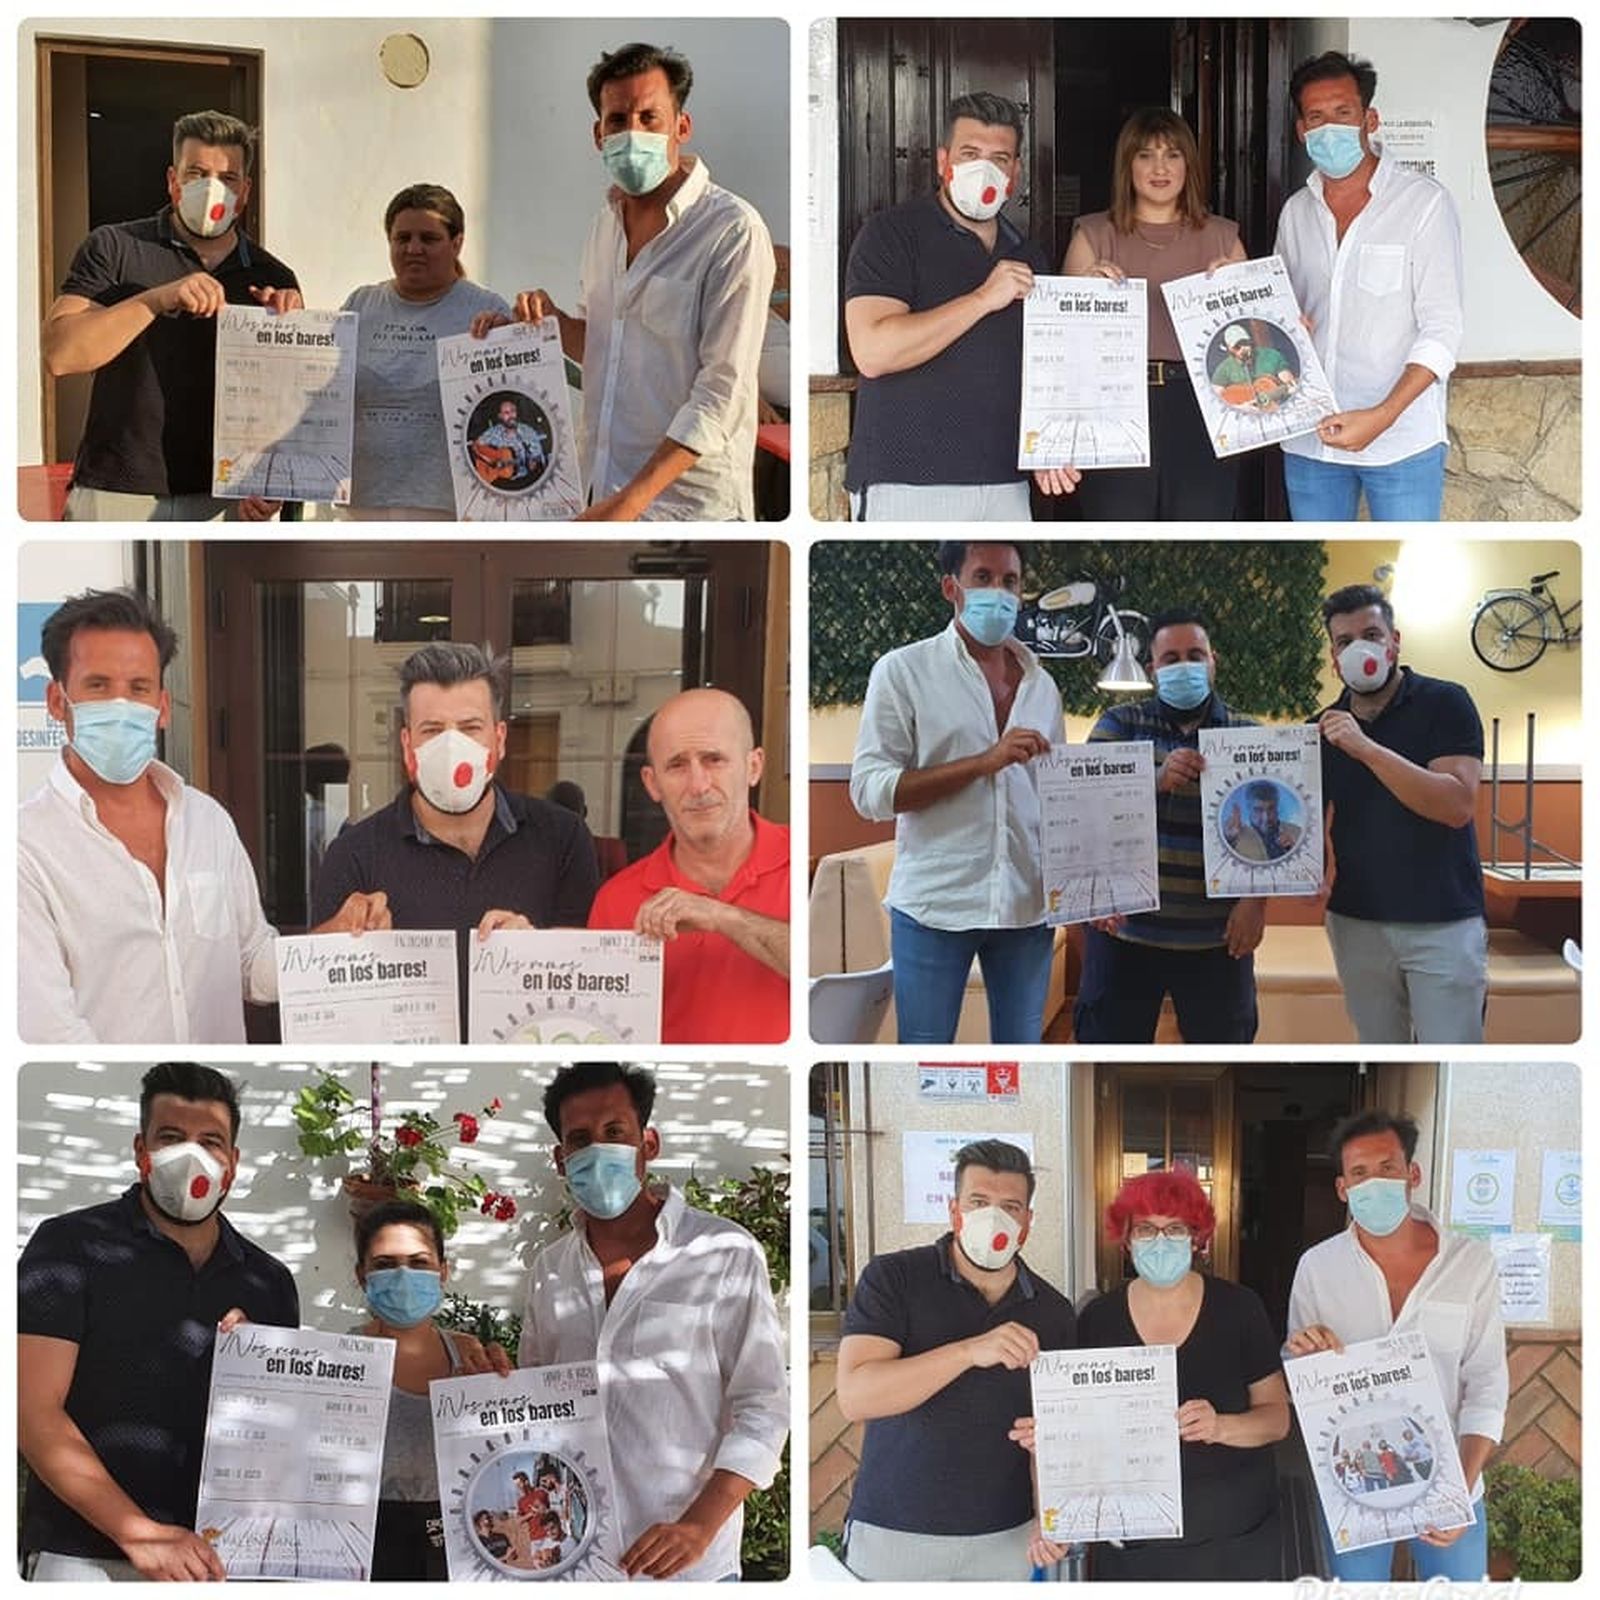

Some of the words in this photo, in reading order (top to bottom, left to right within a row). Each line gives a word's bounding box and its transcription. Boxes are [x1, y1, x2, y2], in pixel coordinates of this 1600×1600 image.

[1059, 299, 1073, 312] en
[1075, 298, 1092, 312] los
[256, 331, 272, 344] en
[274, 330, 294, 345] los
[296, 332, 335, 347] bares!
[470, 359, 485, 374] en
[485, 356, 503, 371] los
[1233, 751, 1247, 763] en
[1249, 750, 1265, 763] los
[1070, 764, 1084, 778] en
[1085, 762, 1101, 777] los
[328, 966, 347, 984] en
[350, 962, 374, 982] los
[377, 959, 428, 980] bares!
[523, 972, 542, 990] en
[547, 971, 573, 991] los
[577, 973, 630, 993] bares!
[266, 1356, 286, 1374] en
[290, 1357, 314, 1376] los
[317, 1360, 366, 1382] bares!
[1072, 1370, 1088, 1385] en
[1092, 1369, 1112, 1385] los
[1115, 1366, 1156, 1382] bares!
[1332, 1382, 1349, 1396] en
[1351, 1376, 1371, 1392] los
[1371, 1364, 1412, 1387] bares!
[480, 1410, 498, 1427] en
[502, 1406, 525, 1424] los
[529, 1399, 576, 1422] bares!
